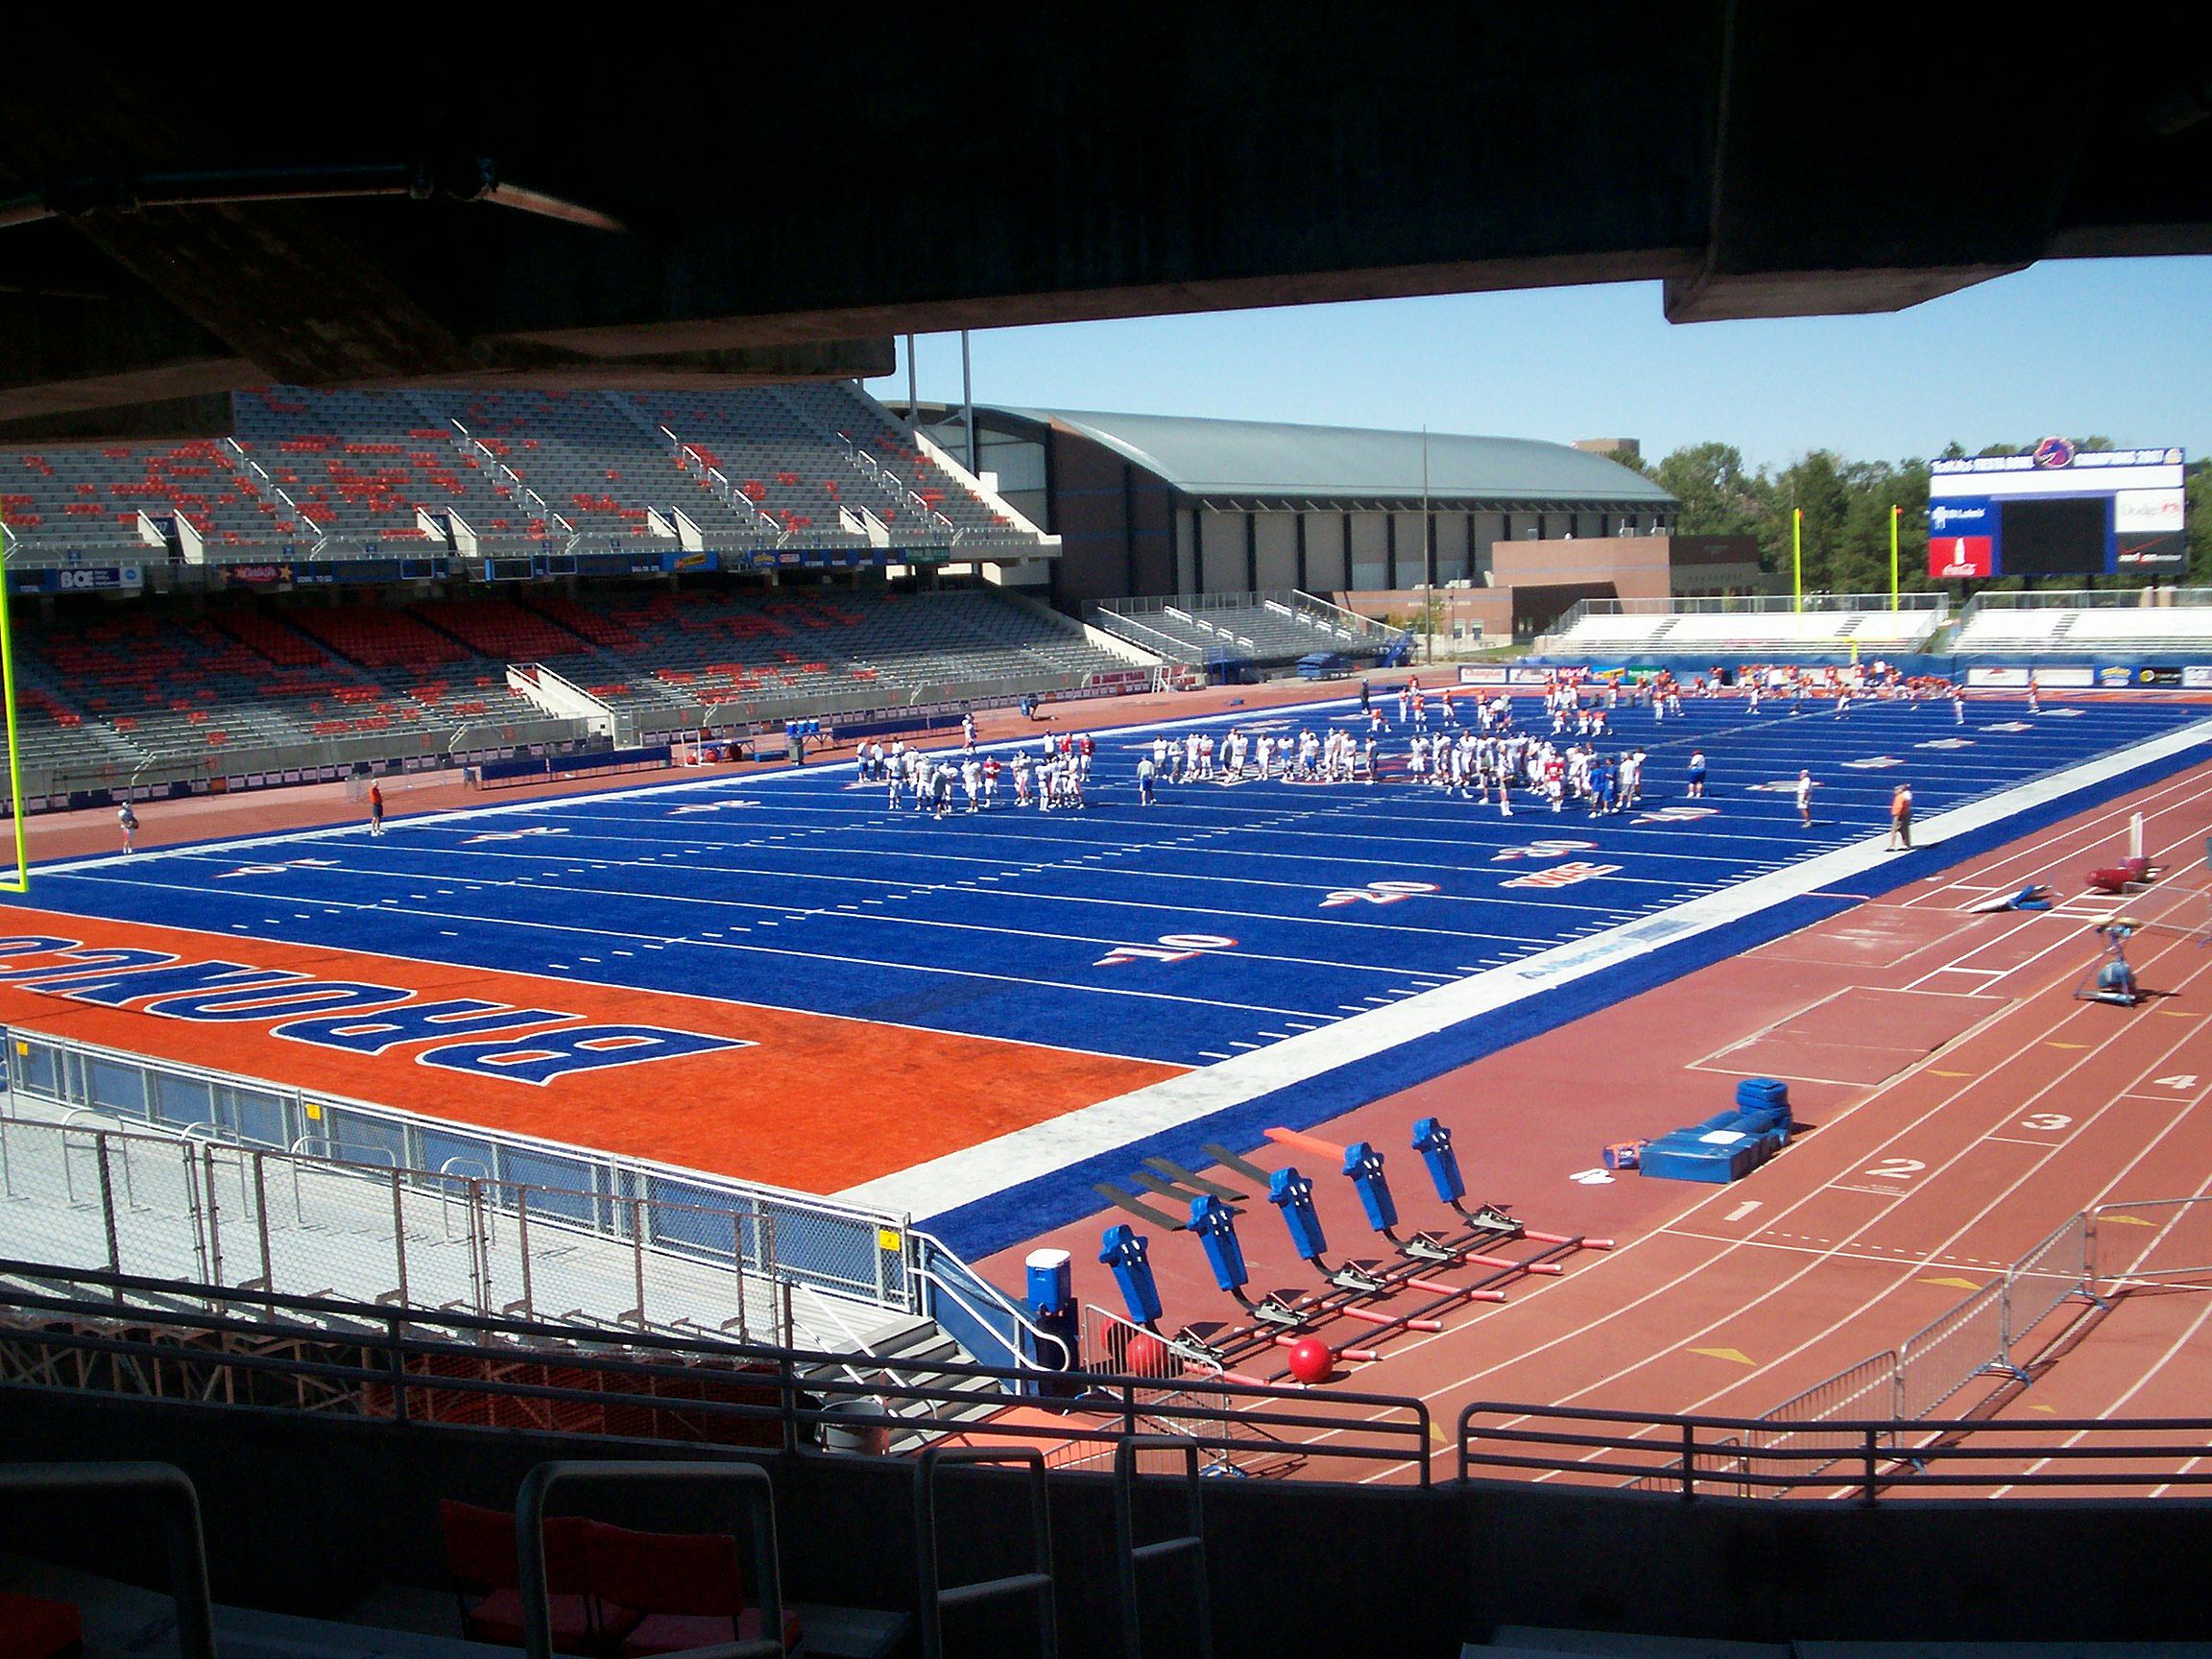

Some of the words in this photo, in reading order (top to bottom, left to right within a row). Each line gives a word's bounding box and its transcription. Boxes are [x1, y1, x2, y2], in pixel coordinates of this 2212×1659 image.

[1498, 840, 1599, 857] 30
[1499, 862, 1623, 888] WAC
[1326, 880, 1440, 904] 20
[1104, 934, 1239, 962] 10
[2152, 1073, 2200, 1090] 4
[2020, 1112, 2074, 1131] 3
[1864, 1158, 1927, 1179] 2
[1722, 1201, 1764, 1221] 1
